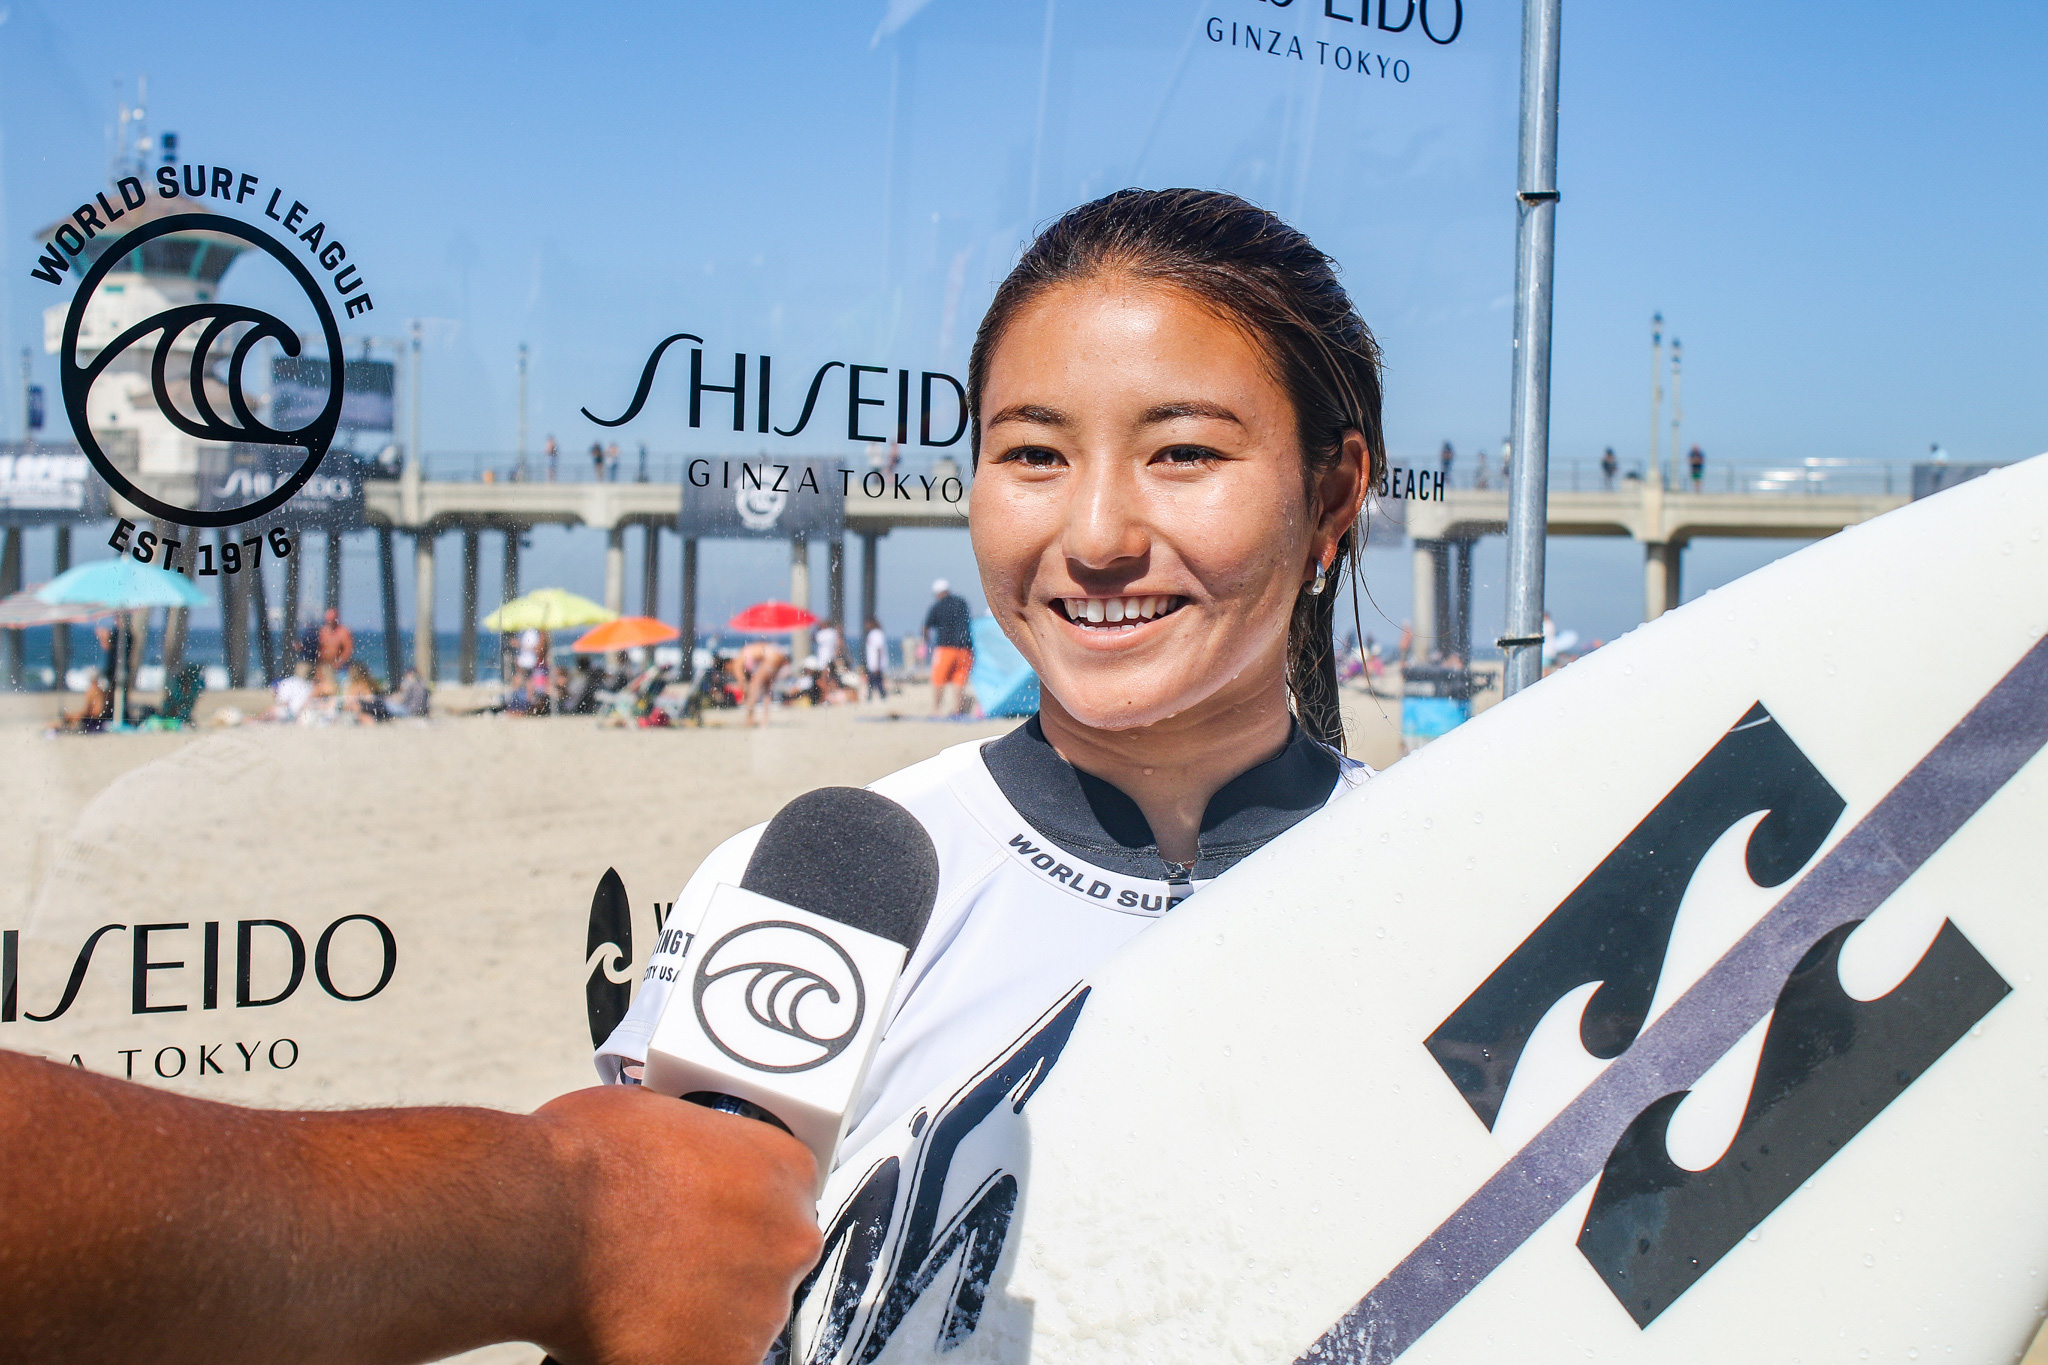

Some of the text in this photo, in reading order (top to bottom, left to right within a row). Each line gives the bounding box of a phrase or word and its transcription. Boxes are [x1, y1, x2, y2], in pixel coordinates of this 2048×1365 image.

[1206, 16, 1304, 61] GINZA
[1315, 40, 1411, 84] TOKYO
[30, 164, 374, 319] WORLD SURF LEAGUE
[580, 332, 969, 448] SHISEID
[688, 458, 964, 504] GINZA TOKYO
[107, 517, 293, 576] EST. 1976
[1008, 833, 1185, 913] WORLD SUR
[1, 913, 398, 1023] ISEIDO
[117, 1038, 300, 1081] TOKYO
